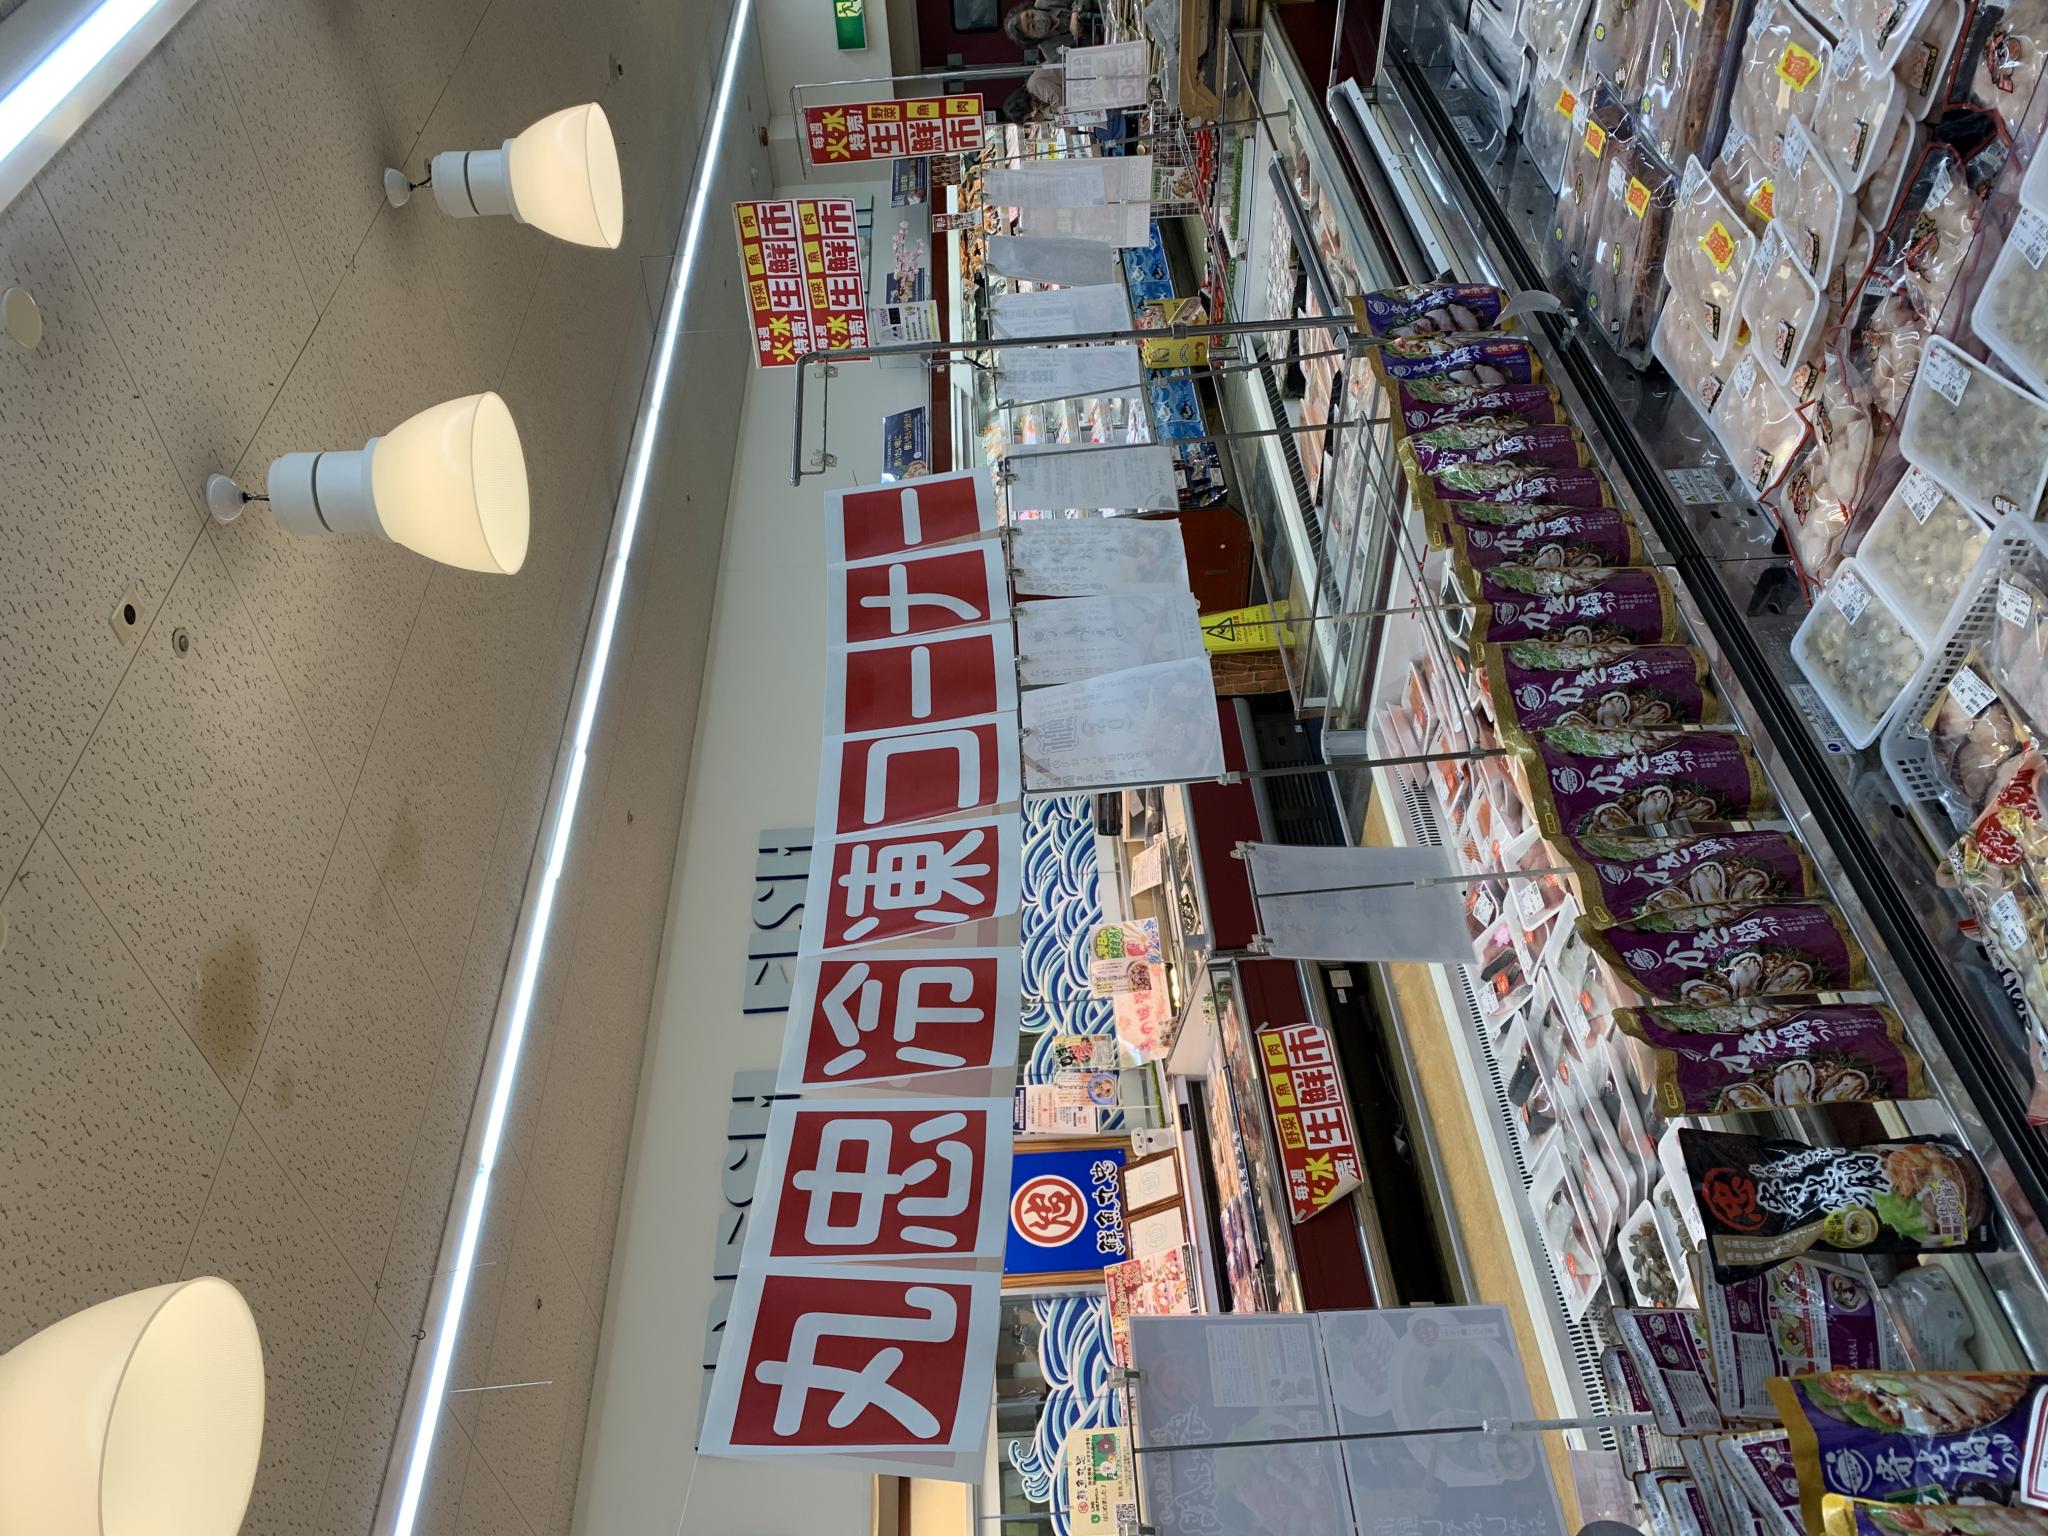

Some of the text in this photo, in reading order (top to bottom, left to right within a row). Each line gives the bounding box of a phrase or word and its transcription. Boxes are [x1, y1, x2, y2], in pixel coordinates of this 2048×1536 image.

[849, 109, 866, 151] 特売!
[871, 100, 969, 120] 野菜 魚 肉
[809, 122, 824, 149] 毎週
[870, 116, 981, 155] 生鮮市
[741, 215, 769, 307] 野菜 魚 肉
[760, 204, 802, 309] 生鮮市
[802, 213, 827, 306] 野菜 魚 肉
[821, 202, 861, 307] 生鮮市
[757, 326, 771, 352] 毎週
[793, 315, 810, 354] 特売!
[1476, 477, 1549, 503] き鍋
[1493, 516, 1576, 553] かき鍋
[1519, 591, 1606, 630] かき鍋
[1548, 660, 1643, 706] かき鍋
[1586, 749, 1684, 796] かき鍋
[755, 487, 990, 1438] 丸忠冷凍コーナー
[1095, 929, 1110, 960] 本日の
[1664, 917, 1770, 971] かき鍋
[1711, 1020, 1821, 1074] かき鍋
[1267, 1043, 1301, 1145] 野菜 魚 肉
[1288, 1027, 1348, 1145] 生鮮市
[1090, 1159, 1125, 1254] 鮮魚丸忠
[1290, 1168, 1309, 1200] 毎週
[1875, 1435, 1999, 1488] 寄せ鍋
